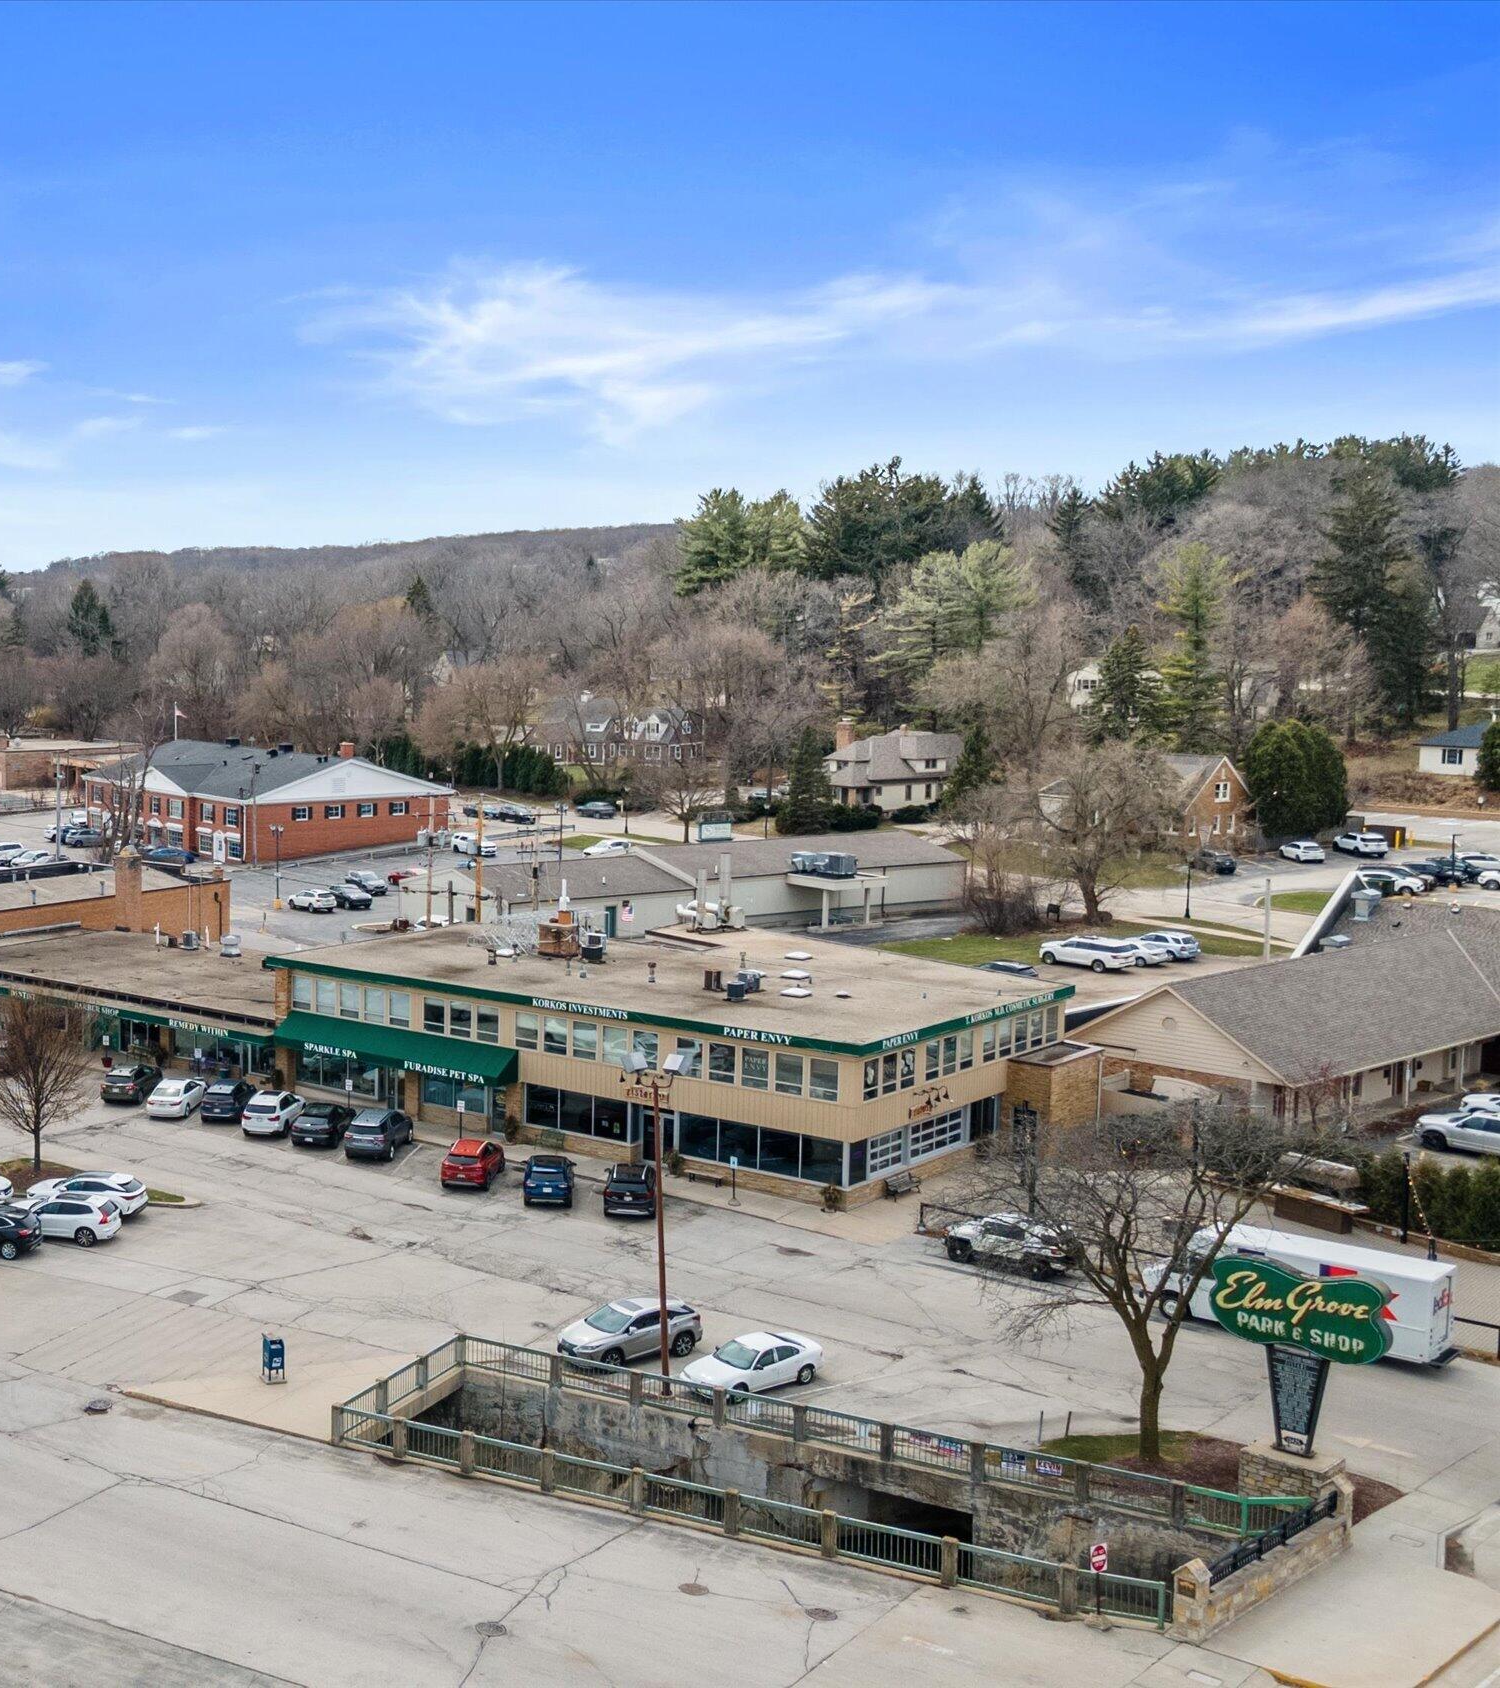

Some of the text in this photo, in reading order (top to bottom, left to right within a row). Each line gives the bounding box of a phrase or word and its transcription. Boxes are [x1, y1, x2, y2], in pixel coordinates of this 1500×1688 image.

[101, 1006, 119, 1017] SHOP
[532, 997, 628, 1020] KORKOS INVESTMENTS
[971, 1009, 993, 1023] KORKOS
[1032, 992, 1054, 1006] SURGERY
[168, 1018, 229, 1037] REMEDY WITHIN
[723, 1026, 793, 1046] PAPER ENVY
[882, 1031, 919, 1050] PAPER ENVY
[303, 1042, 358, 1060] SPARKLE SPA
[403, 1060, 485, 1085] FURADISE PET SPA
[1215, 1270, 1372, 1325] Elm Grove
[1237, 1311, 1287, 1337] PARK
[1309, 1329, 1365, 1355] SHOP
[1038, 1459, 1062, 1471] KEVIN
